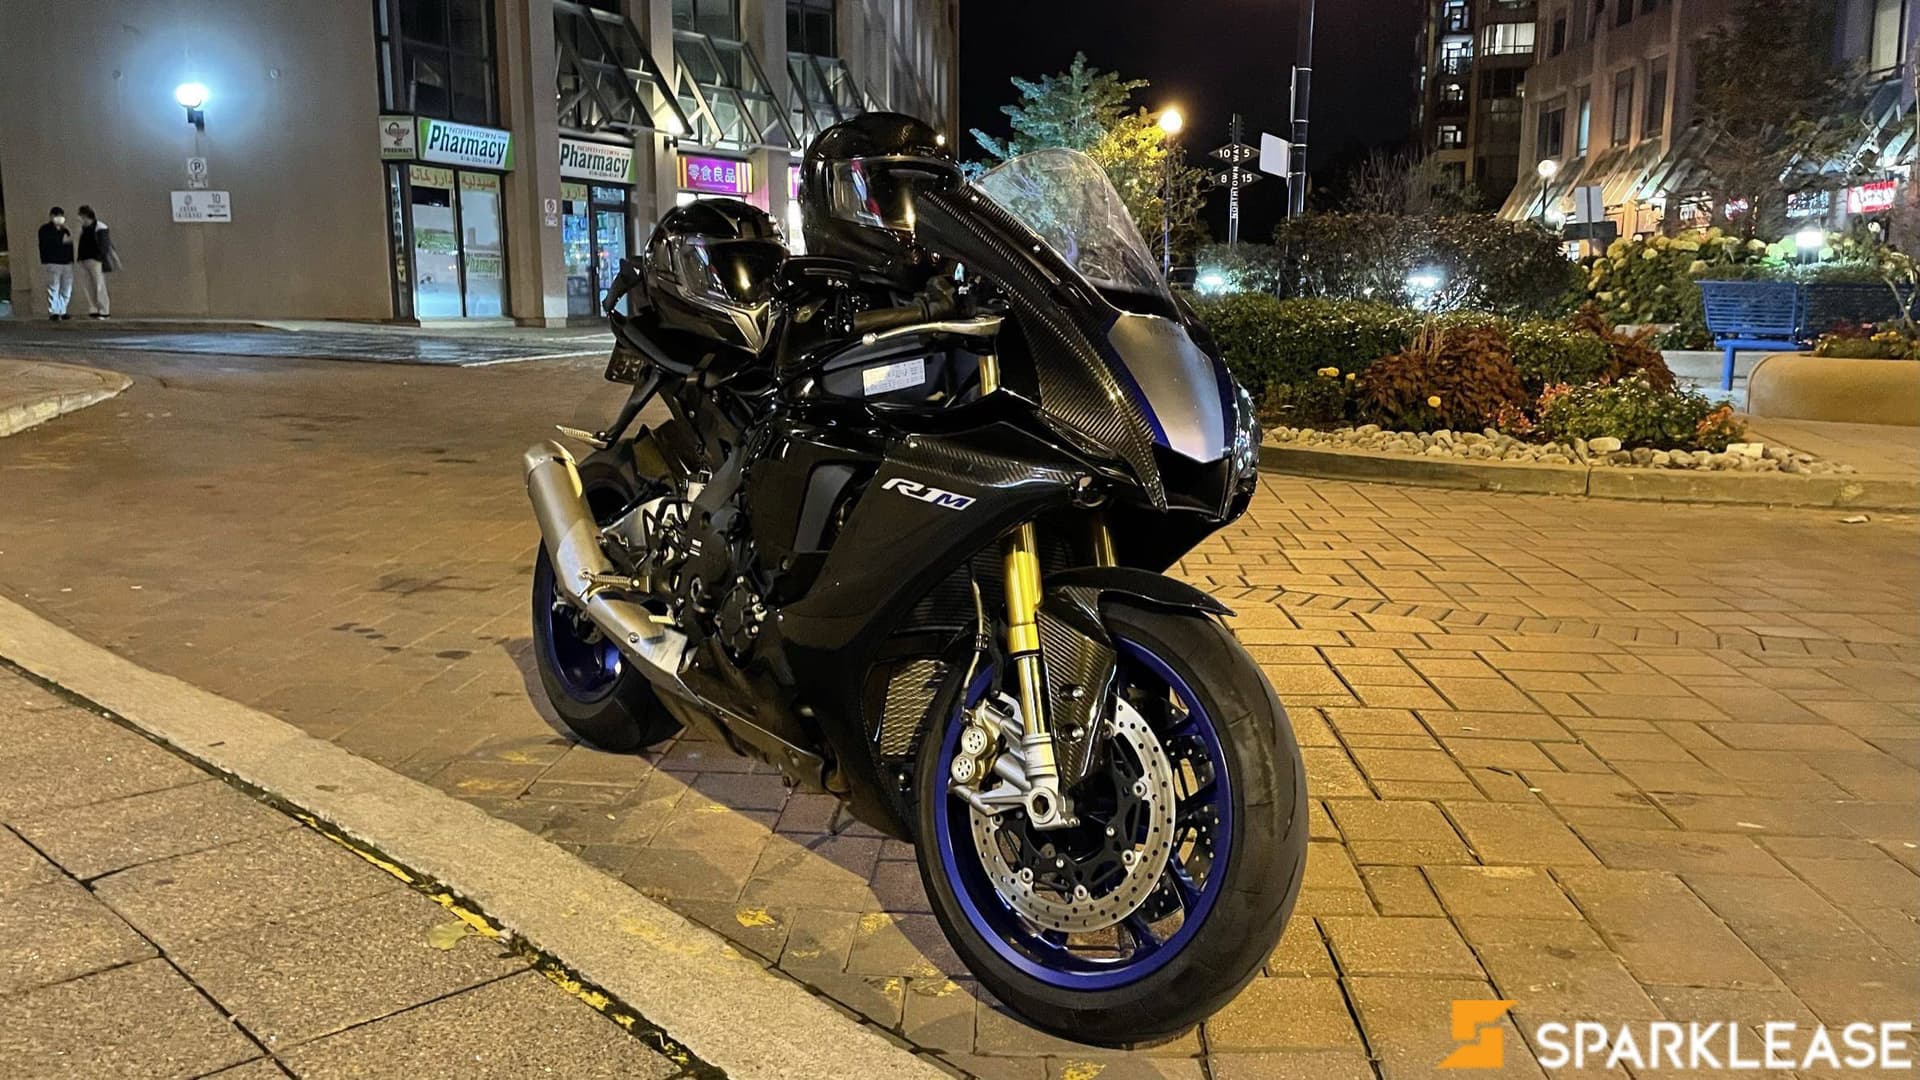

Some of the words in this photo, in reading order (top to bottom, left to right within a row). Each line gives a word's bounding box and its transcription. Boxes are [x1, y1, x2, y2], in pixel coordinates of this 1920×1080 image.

[429, 125, 506, 165] Pharmacy
[560, 143, 629, 179] Pharmacy
[1219, 149, 1231, 158] 10
[1243, 149, 1250, 158] 5
[688, 163, 736, 183] 零食良品
[1221, 174, 1228, 183] 8
[1241, 173, 1253, 183] 15
[212, 193, 221, 204] 10
[1231, 166, 1239, 219] NORTHTOWN
[881, 478, 977, 511] R1M
